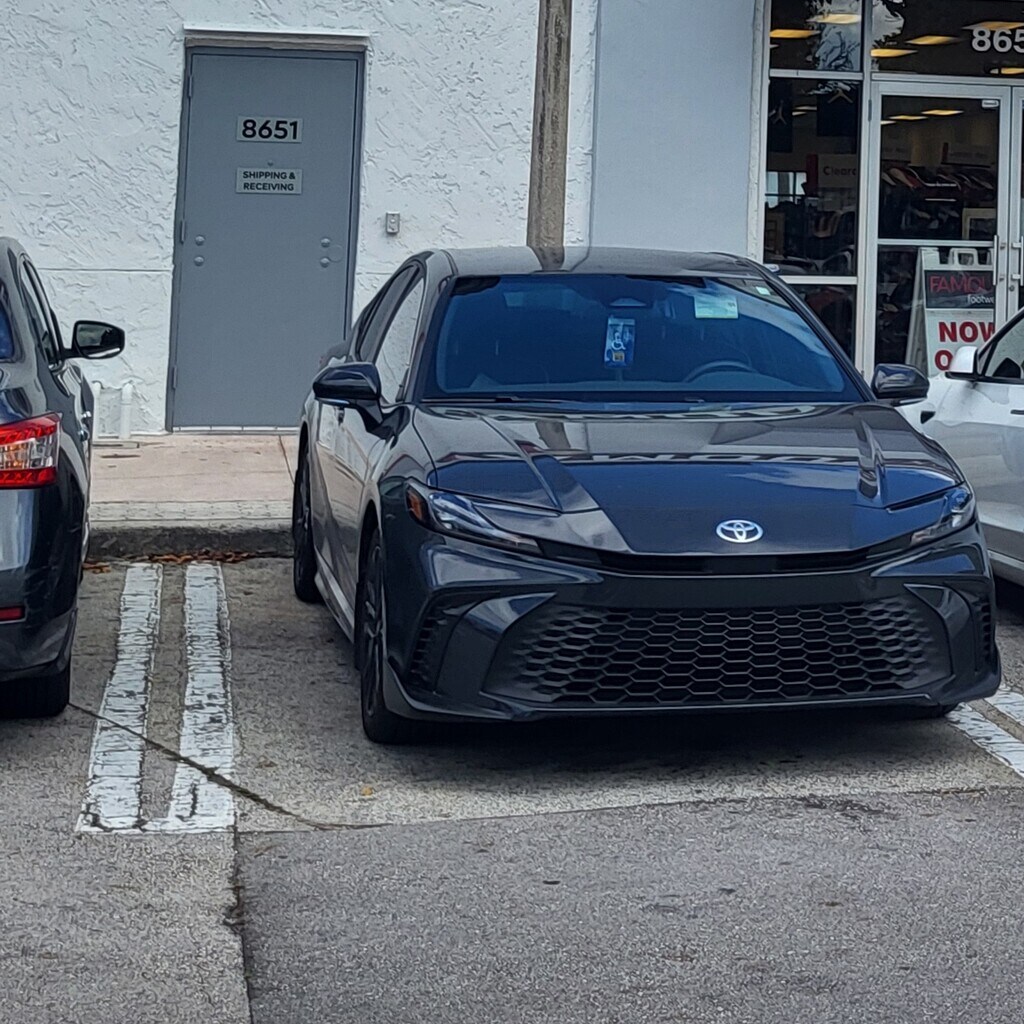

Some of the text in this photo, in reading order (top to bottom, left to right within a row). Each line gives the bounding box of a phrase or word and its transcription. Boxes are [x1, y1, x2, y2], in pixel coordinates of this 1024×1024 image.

[241, 119, 298, 140] 8651
[242, 171, 296, 180] SHIPPING &
[823, 166, 857, 176] Clear
[243, 182, 295, 192] RECEIVING
[929, 275, 994, 294] FAMOU
